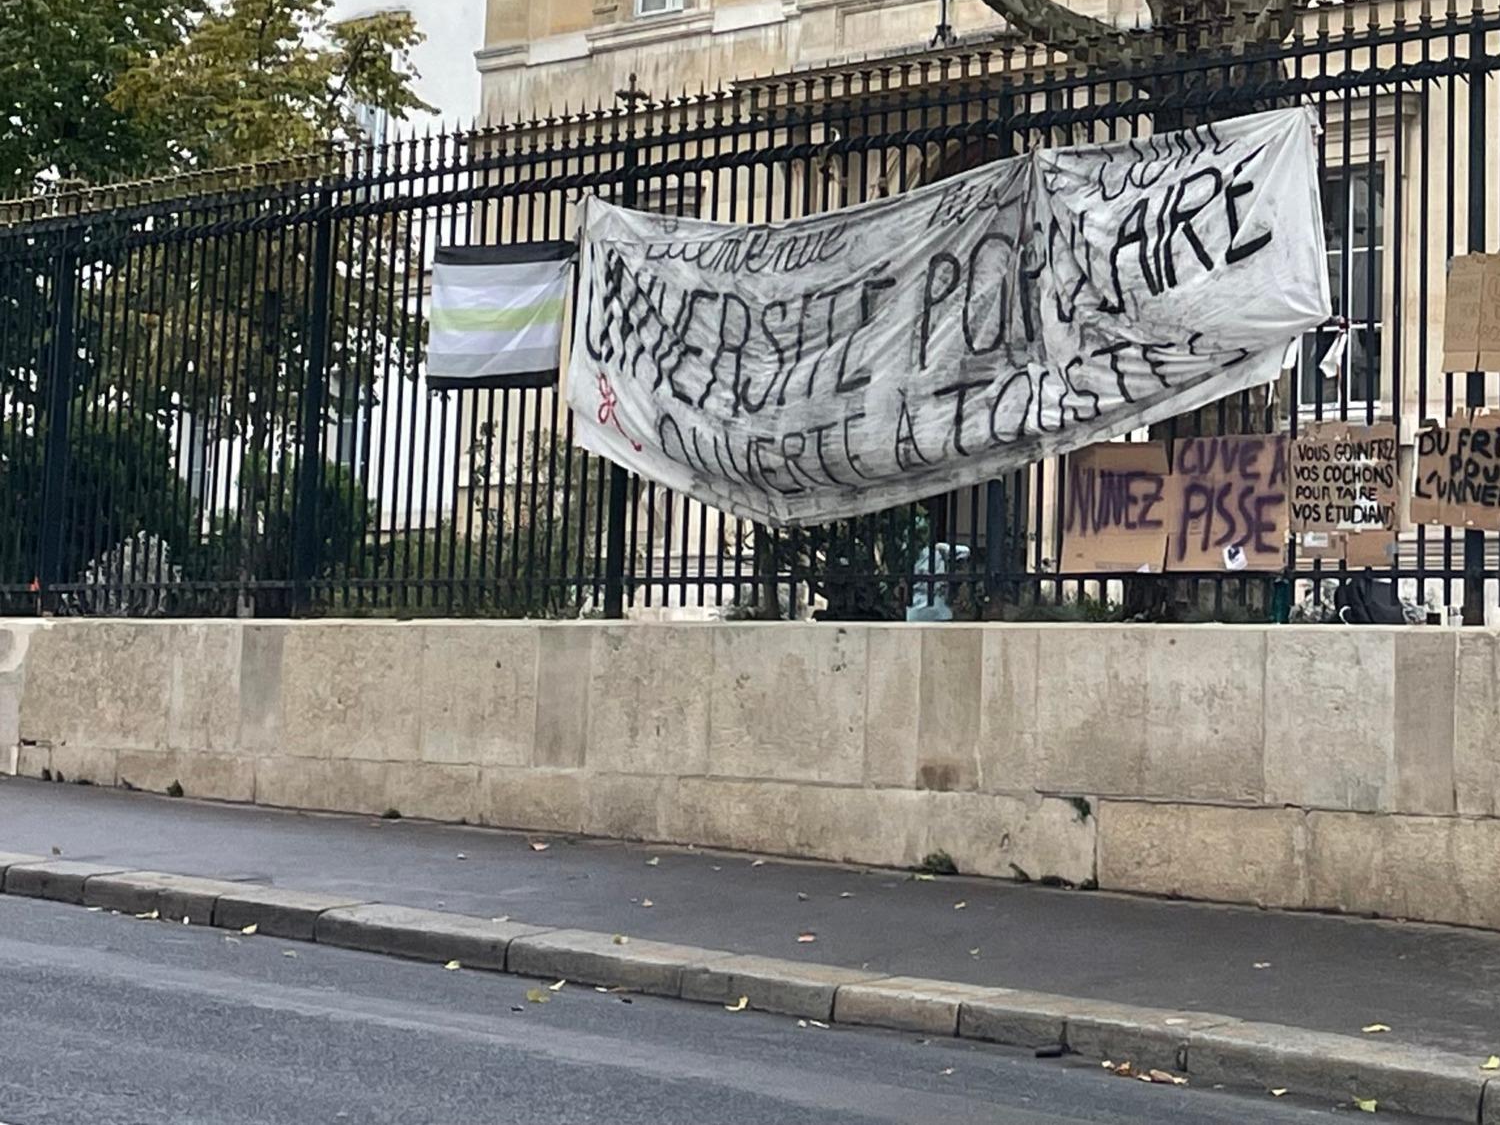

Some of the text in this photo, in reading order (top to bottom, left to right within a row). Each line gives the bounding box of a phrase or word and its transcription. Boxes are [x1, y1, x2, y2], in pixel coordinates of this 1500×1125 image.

[1297, 443, 1330, 462] VOUS
[1418, 430, 1450, 457] DU
[1177, 438, 1264, 480] CUVE
[1293, 463, 1394, 489] VOS COCHONS
[1295, 485, 1331, 501] POUR
[1176, 481, 1286, 563] PISSE
[1292, 502, 1321, 523] VOS
